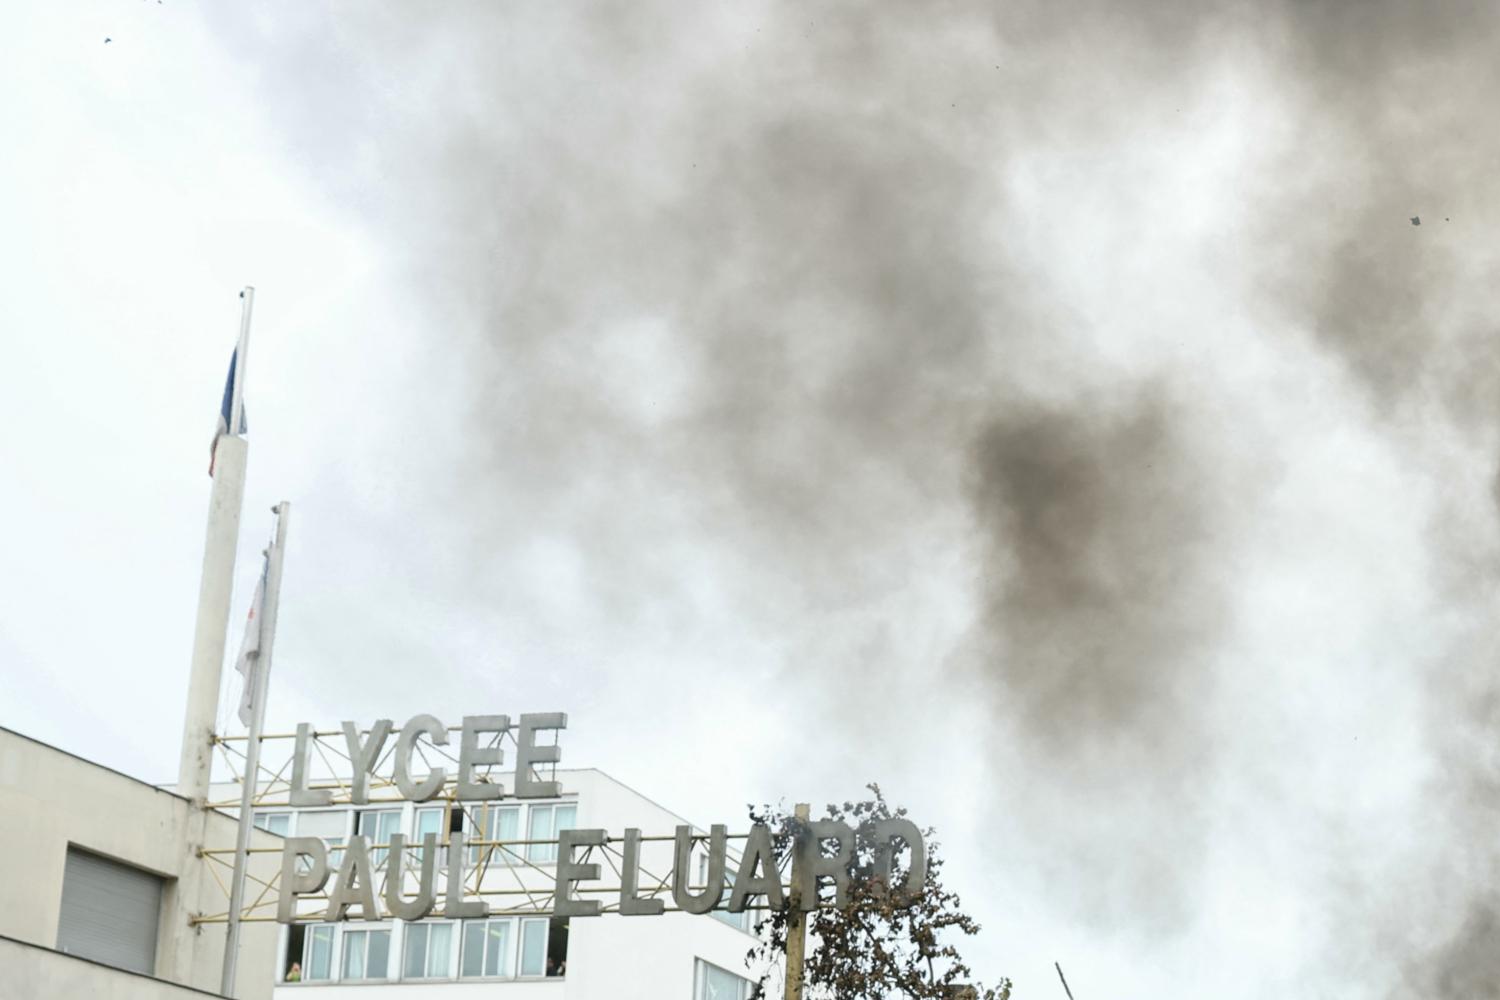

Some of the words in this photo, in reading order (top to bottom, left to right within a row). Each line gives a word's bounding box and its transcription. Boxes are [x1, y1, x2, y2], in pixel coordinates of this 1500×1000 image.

[289, 712, 567, 806] LYCEE
[278, 831, 489, 923] PAUL
[554, 818, 926, 917] ELUARD
